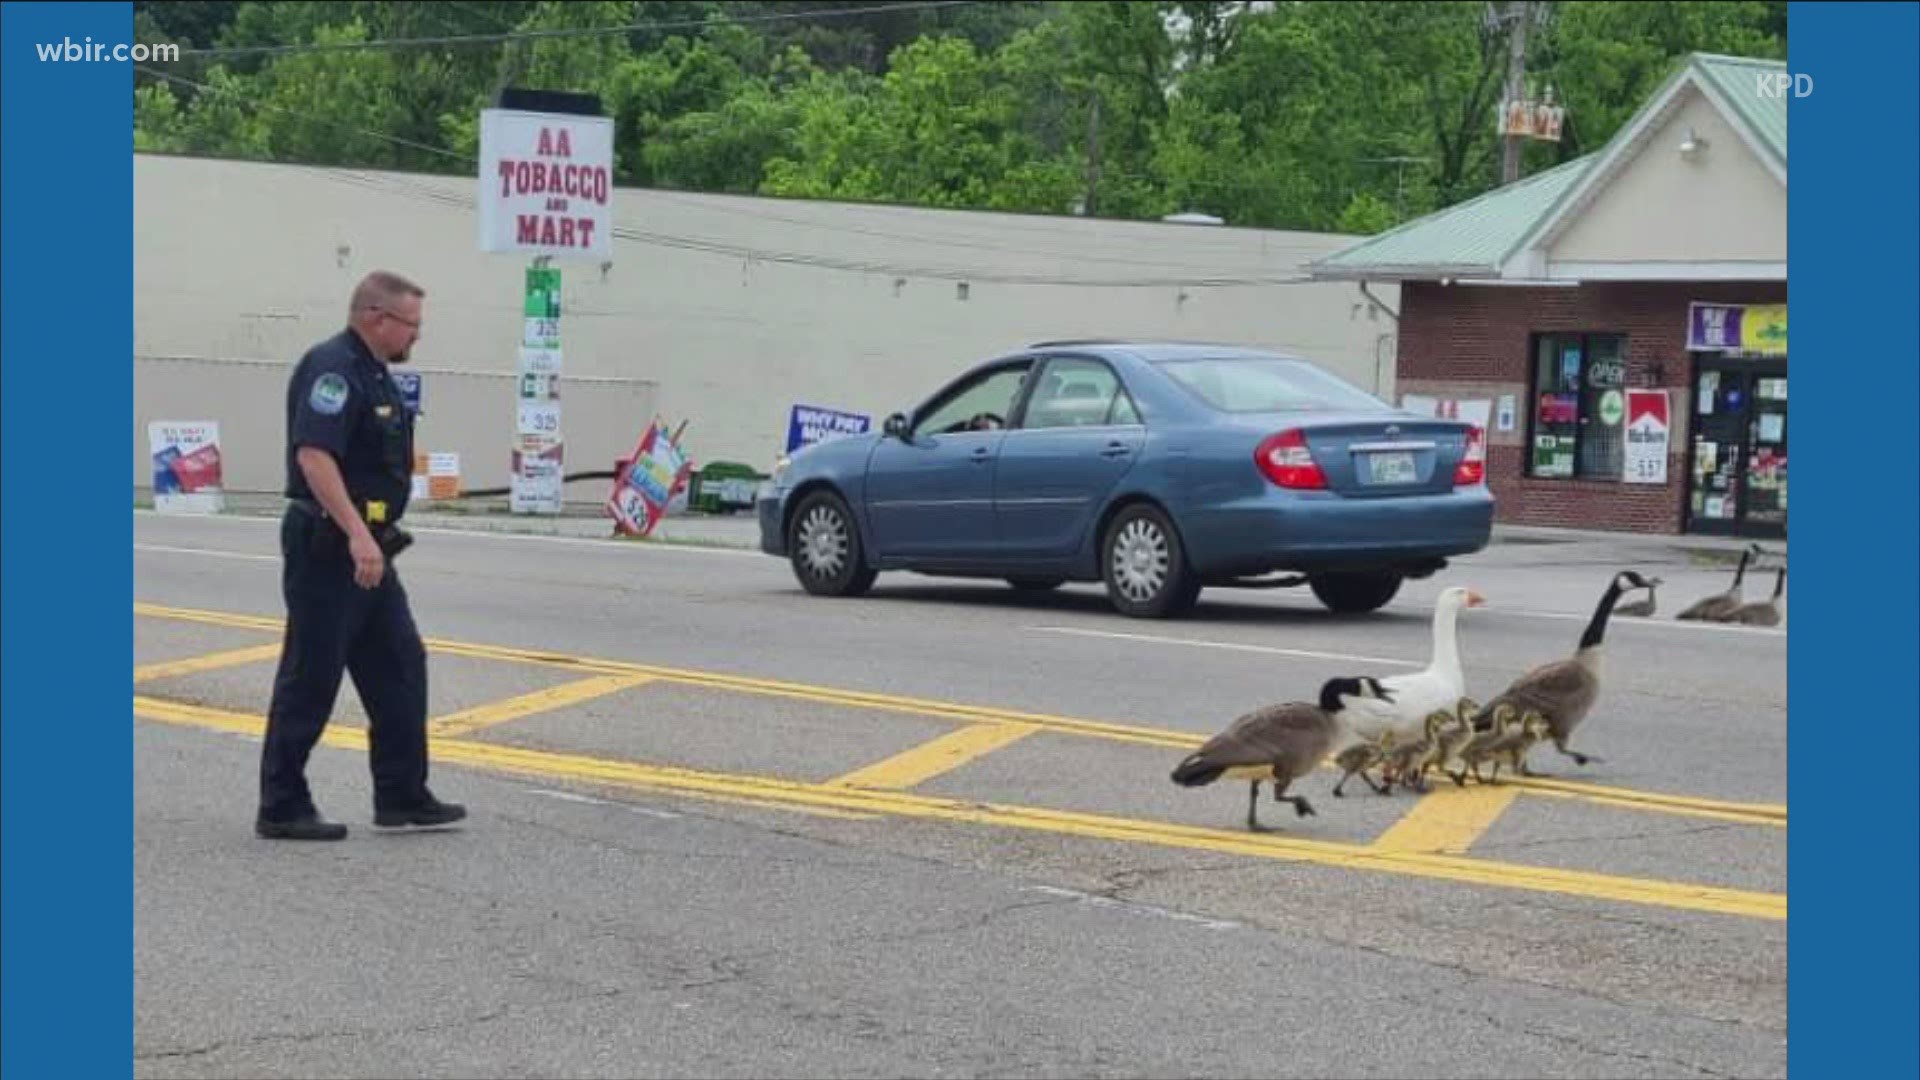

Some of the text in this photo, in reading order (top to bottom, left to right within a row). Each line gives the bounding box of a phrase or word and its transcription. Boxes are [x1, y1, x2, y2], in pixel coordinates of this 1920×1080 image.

[537, 127, 571, 157] AA
[498, 160, 607, 205] TOBACCO
[545, 198, 568, 211] AND
[516, 214, 595, 248] MART
